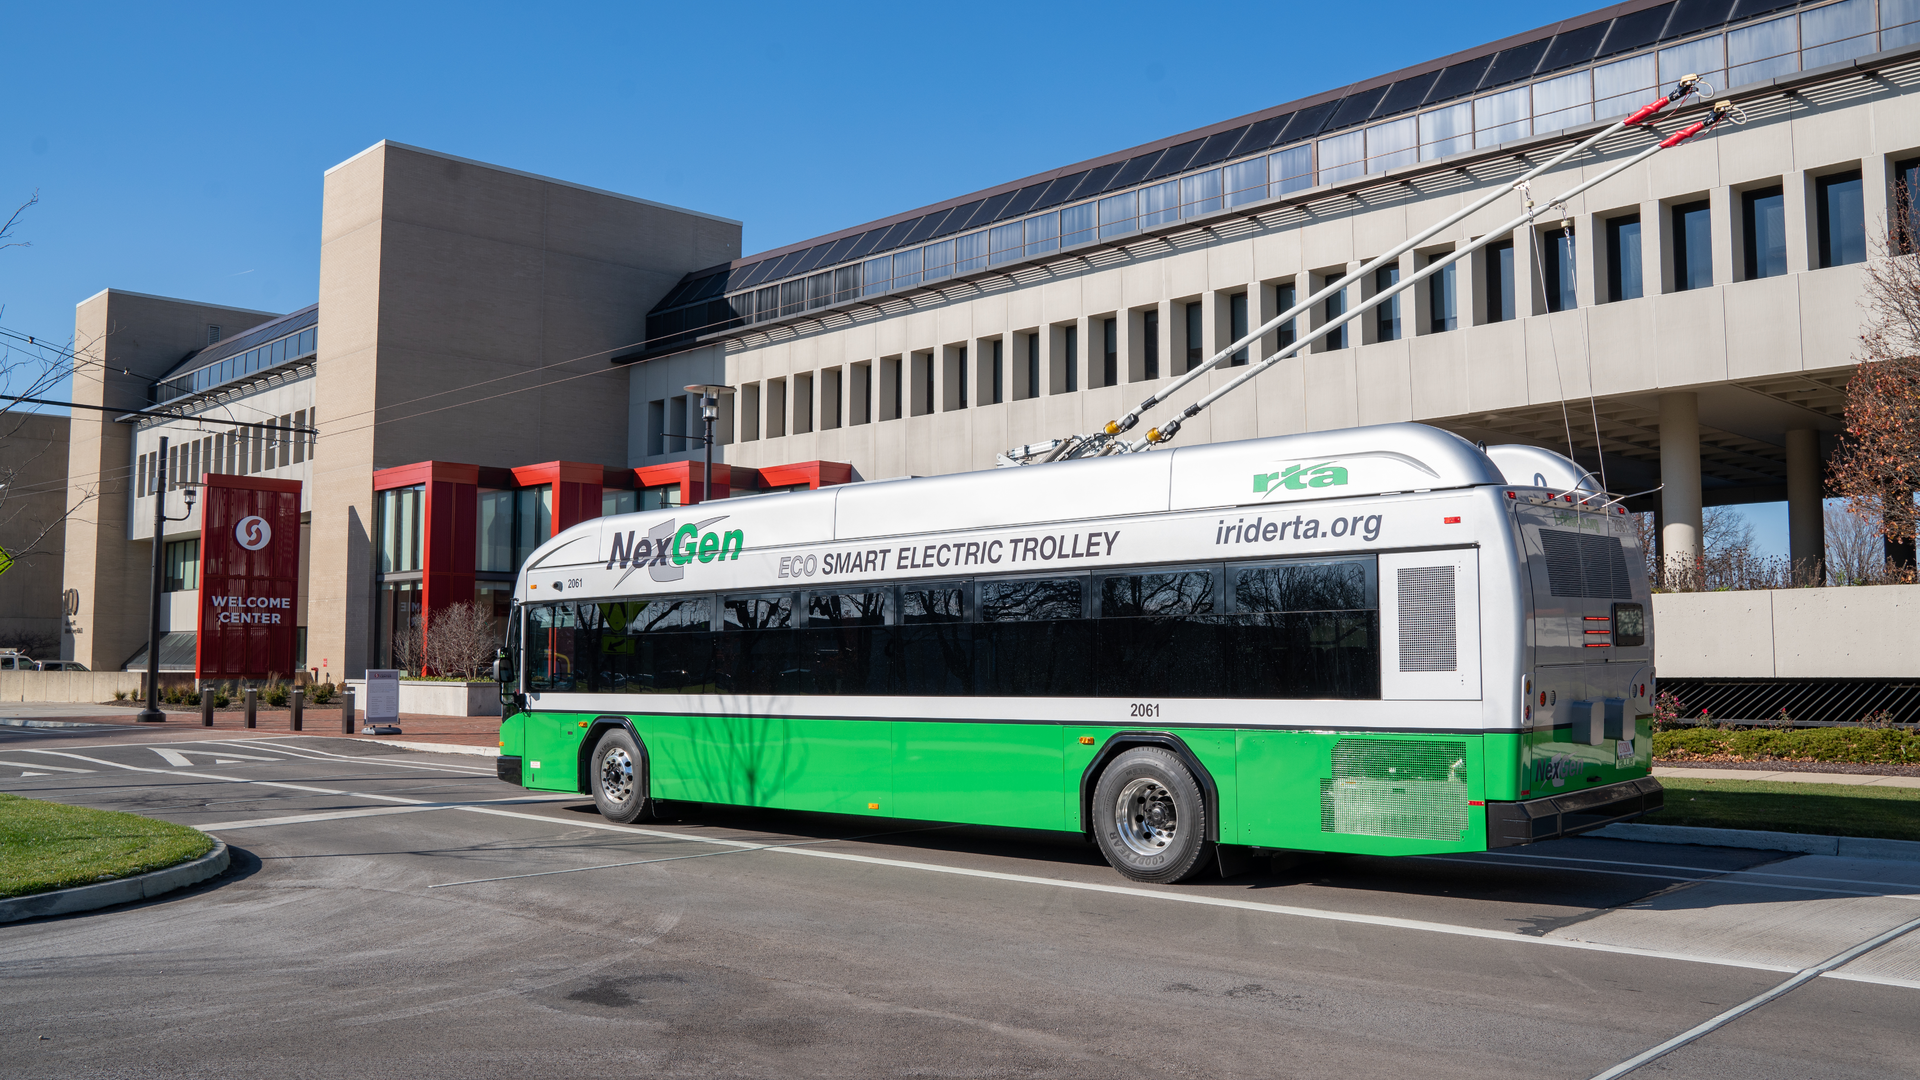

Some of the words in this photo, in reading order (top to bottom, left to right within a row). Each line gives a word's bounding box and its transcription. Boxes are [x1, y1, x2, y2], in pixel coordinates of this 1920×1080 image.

[1253, 462, 1348, 495] rta
[1215, 514, 1383, 545] iriderta.org
[606, 523, 744, 570] NexGen
[778, 554, 818, 579] ECO
[822, 548, 891, 575] SMART
[897, 540, 1003, 570] ELECTRIC
[1009, 530, 1120, 562] TROLLEY
[567, 578, 583, 589] 2061
[211, 595, 291, 609] WELCOME
[219, 611, 281, 624] CENTER
[1130, 703, 1160, 717] 2061
[1535, 754, 1584, 782] NexGen
